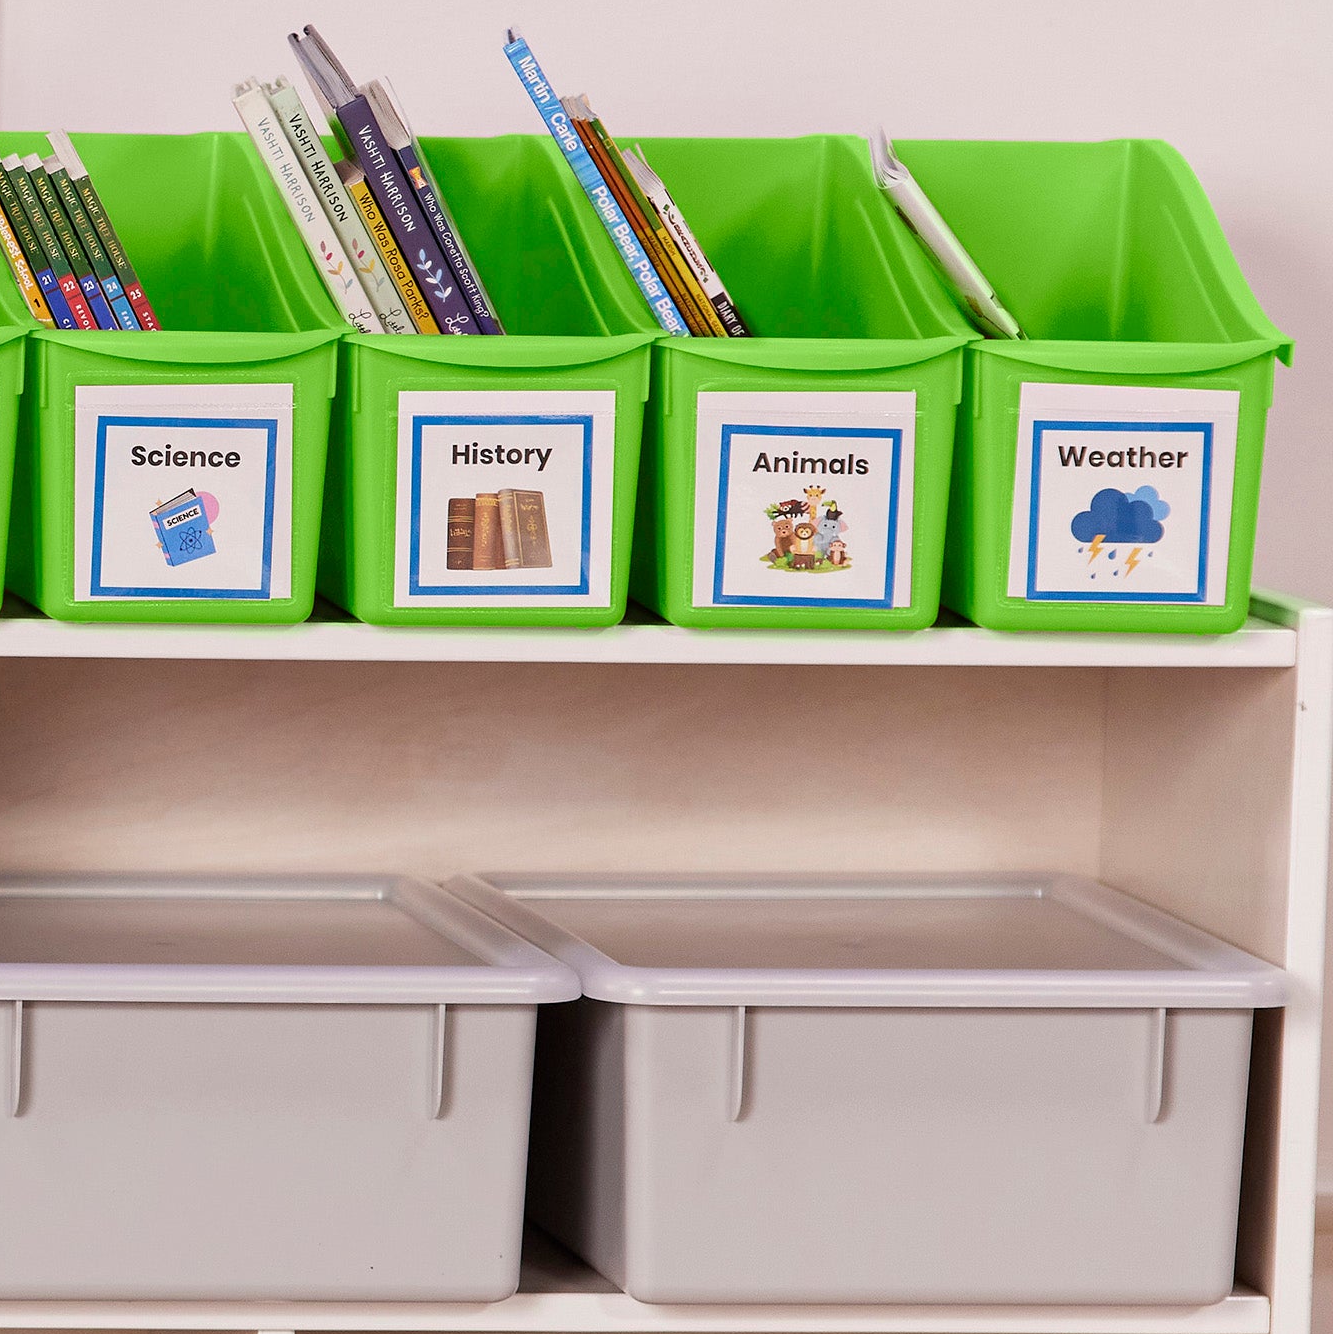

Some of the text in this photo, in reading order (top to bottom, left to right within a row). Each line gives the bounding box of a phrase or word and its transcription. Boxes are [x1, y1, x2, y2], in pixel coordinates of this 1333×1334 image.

[517, 55, 551, 104] Martin
[550, 112, 578, 152] Carle
[258, 117, 316, 223] VASHTI HARRISON
[289, 113, 348, 222] VASHTI HARRISON
[358, 125, 416, 233] VASHTI HARRISON
[17, 177, 36, 207] MAGIC
[36, 177, 55, 207] MAGIC
[59, 178, 78, 207] MAGIC
[82, 187, 100, 216] MAGIC
[359, 192, 430, 320] Who Was Rosa Parks?
[423, 192, 490, 318] Who Was Coretta Scott King?
[591, 186, 621, 225] Polar
[613, 222, 641, 263] Bear,
[633, 261, 663, 300] Polar
[42, 275, 53, 286] 21
[63, 281, 76, 292] 22
[83, 281, 95, 291] 23
[106, 282, 118, 293] 24
[130, 289, 142, 300] 25
[34, 298, 41, 308] 1
[717, 301, 745, 336] DIARY OF
[130, 444, 241, 468] Science
[451, 442, 553, 472] History
[752, 450, 870, 477] Animals
[1057, 443, 1189, 469] Weather
[167, 508, 199, 527] SCIENCE
